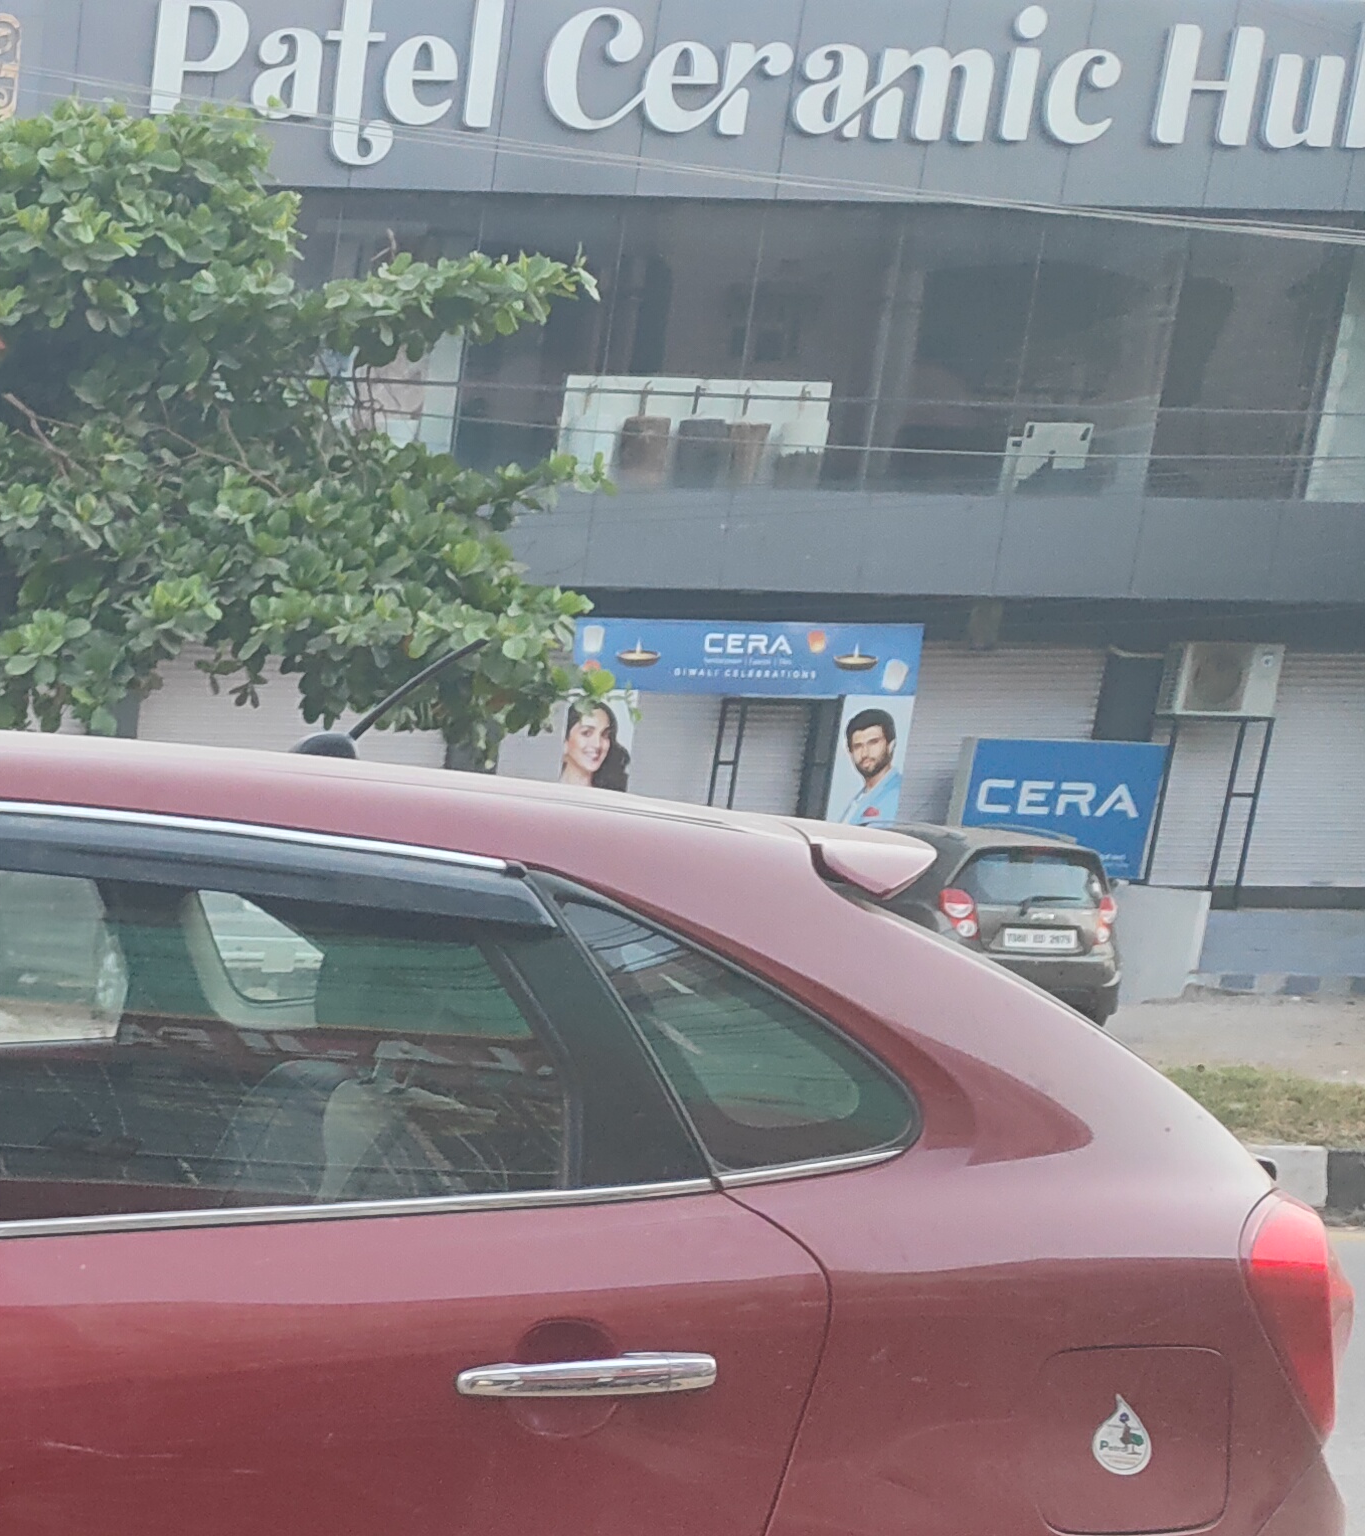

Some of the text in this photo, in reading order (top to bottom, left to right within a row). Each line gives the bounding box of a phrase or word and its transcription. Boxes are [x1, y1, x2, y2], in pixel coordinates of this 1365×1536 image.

[149, 0, 1365, 164] Patel Ceramic Hu
[704, 633, 792, 654] CERA
[977, 778, 1139, 818] CERA
